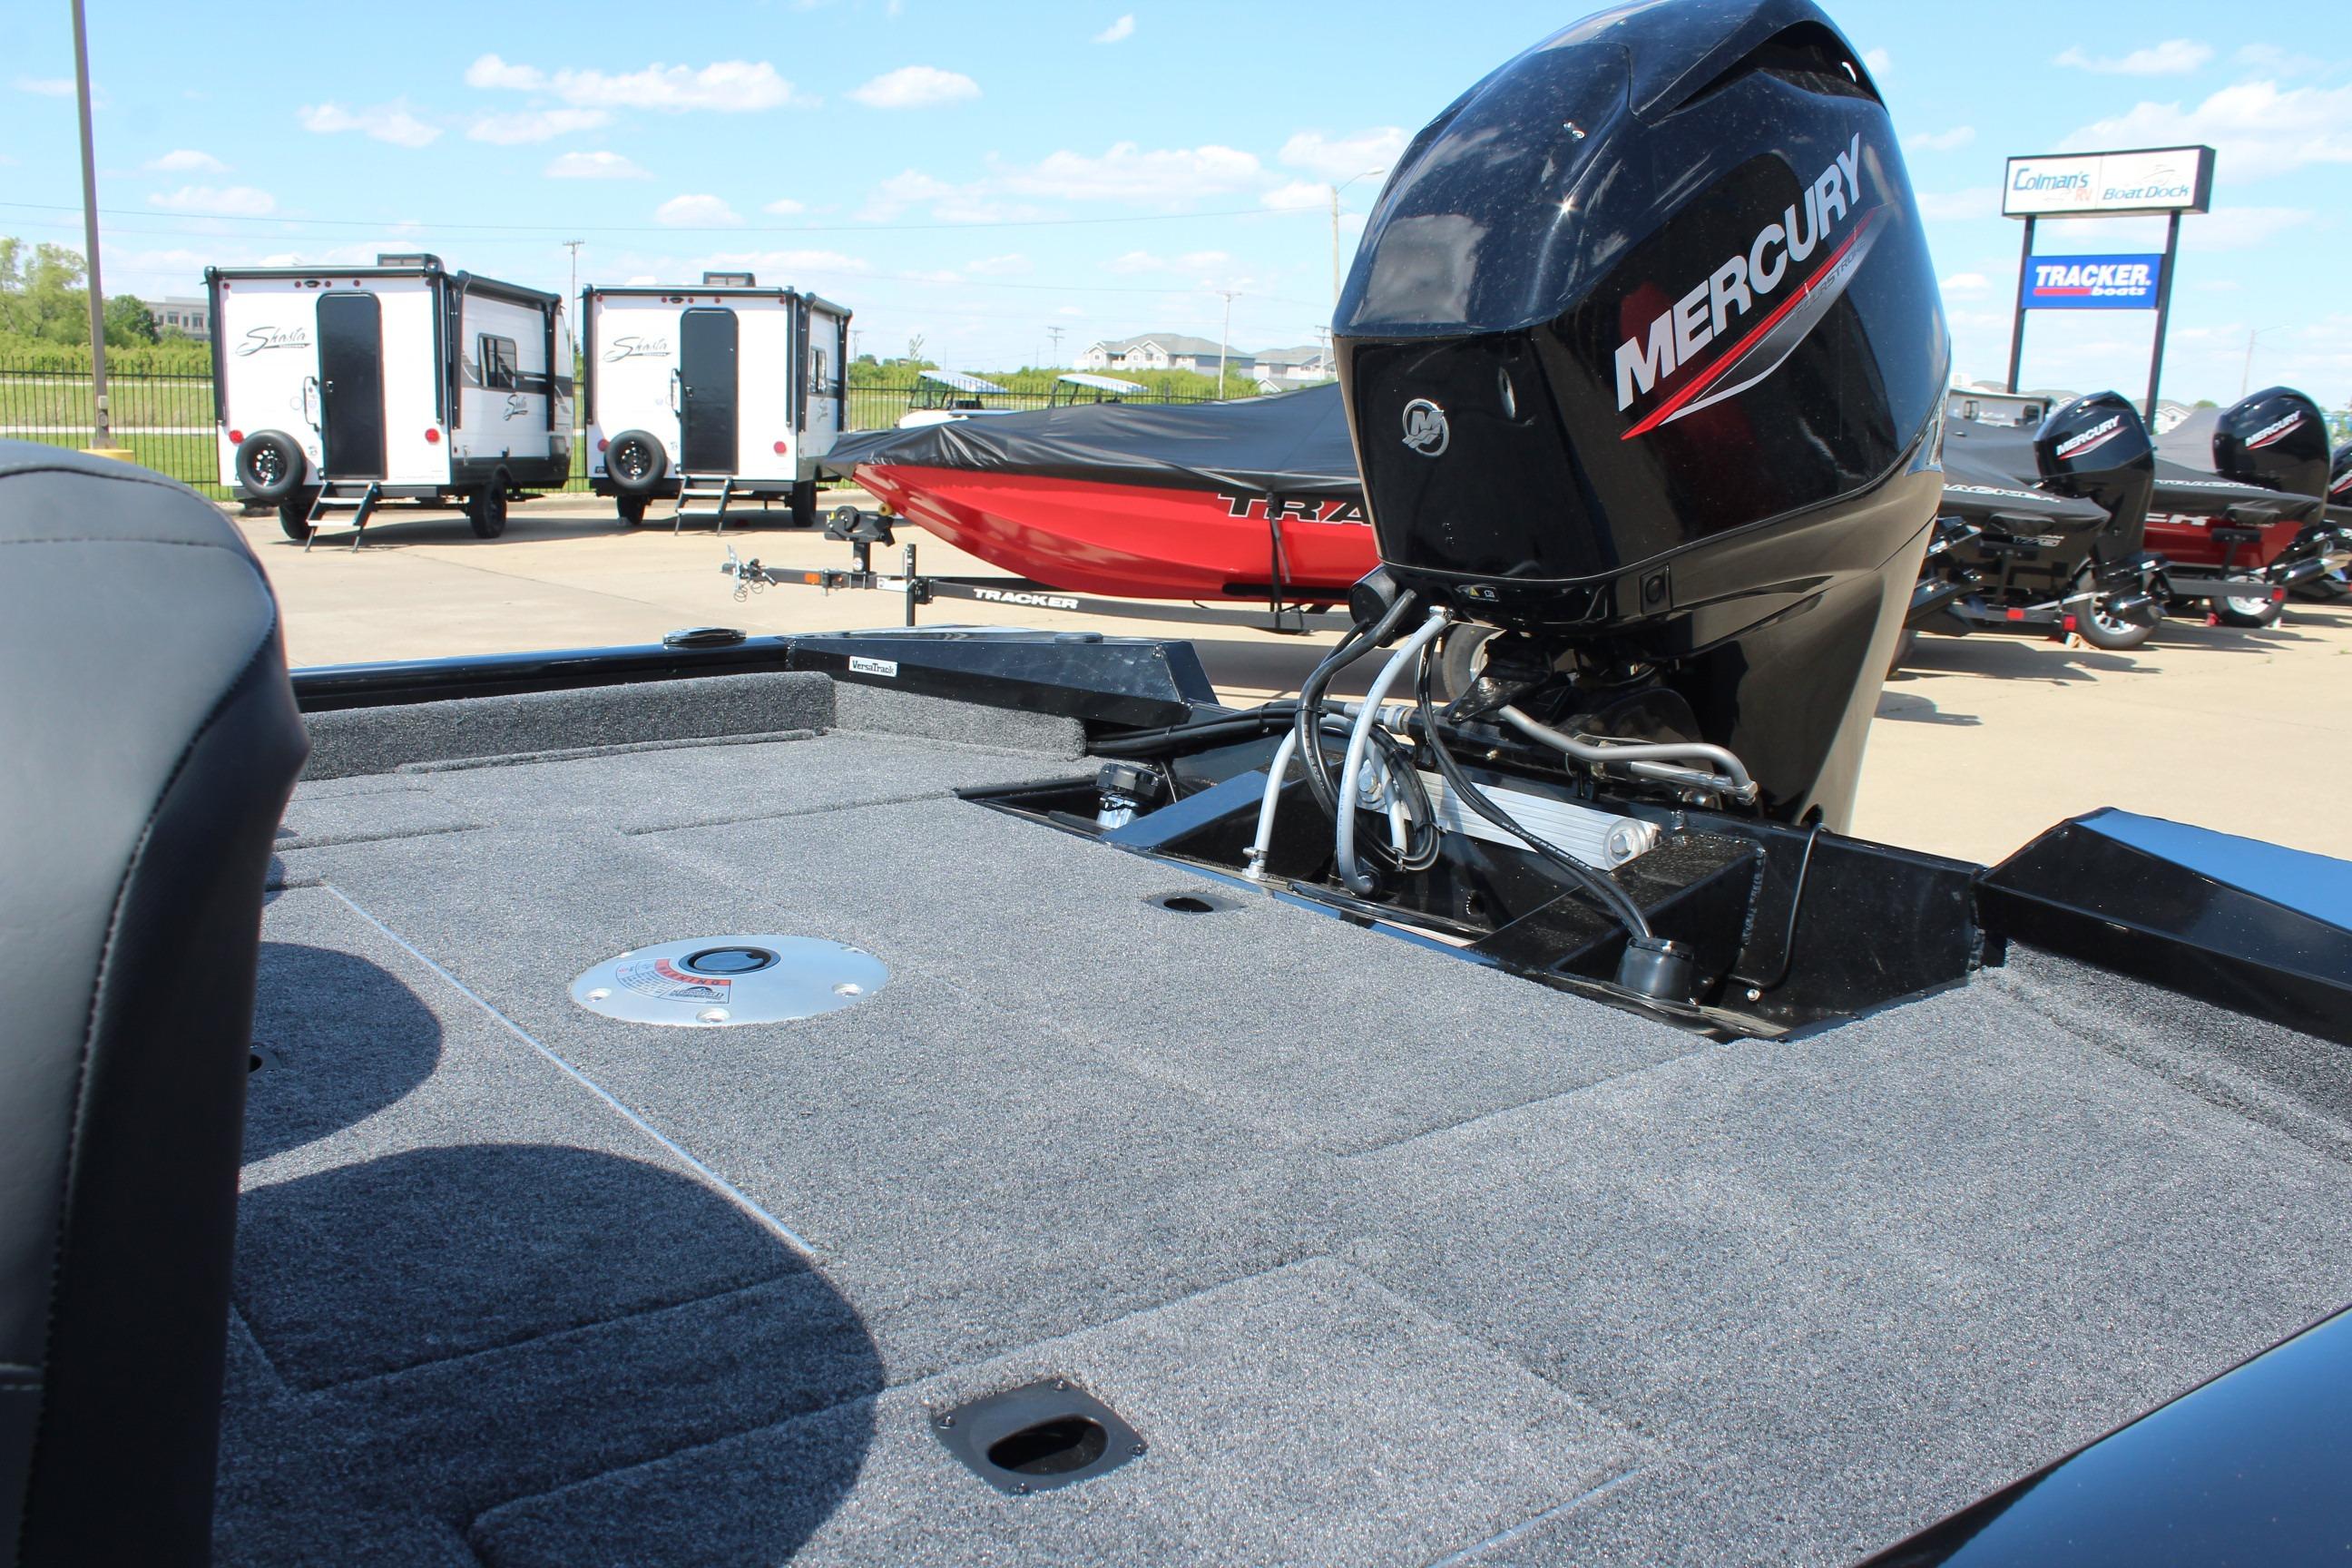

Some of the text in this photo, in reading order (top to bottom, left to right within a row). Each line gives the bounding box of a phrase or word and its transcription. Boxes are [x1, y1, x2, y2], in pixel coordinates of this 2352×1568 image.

[2012, 167, 2091, 192] Colman's
[2102, 184, 2190, 201] Boat Dock
[1614, 132, 1862, 412] MERCURY
[2055, 415, 2122, 456] MERCURY
[2244, 409, 2302, 447] MERCURY
[973, 588, 1080, 610] TRACKER
[851, 659, 896, 675] VersaTrack
